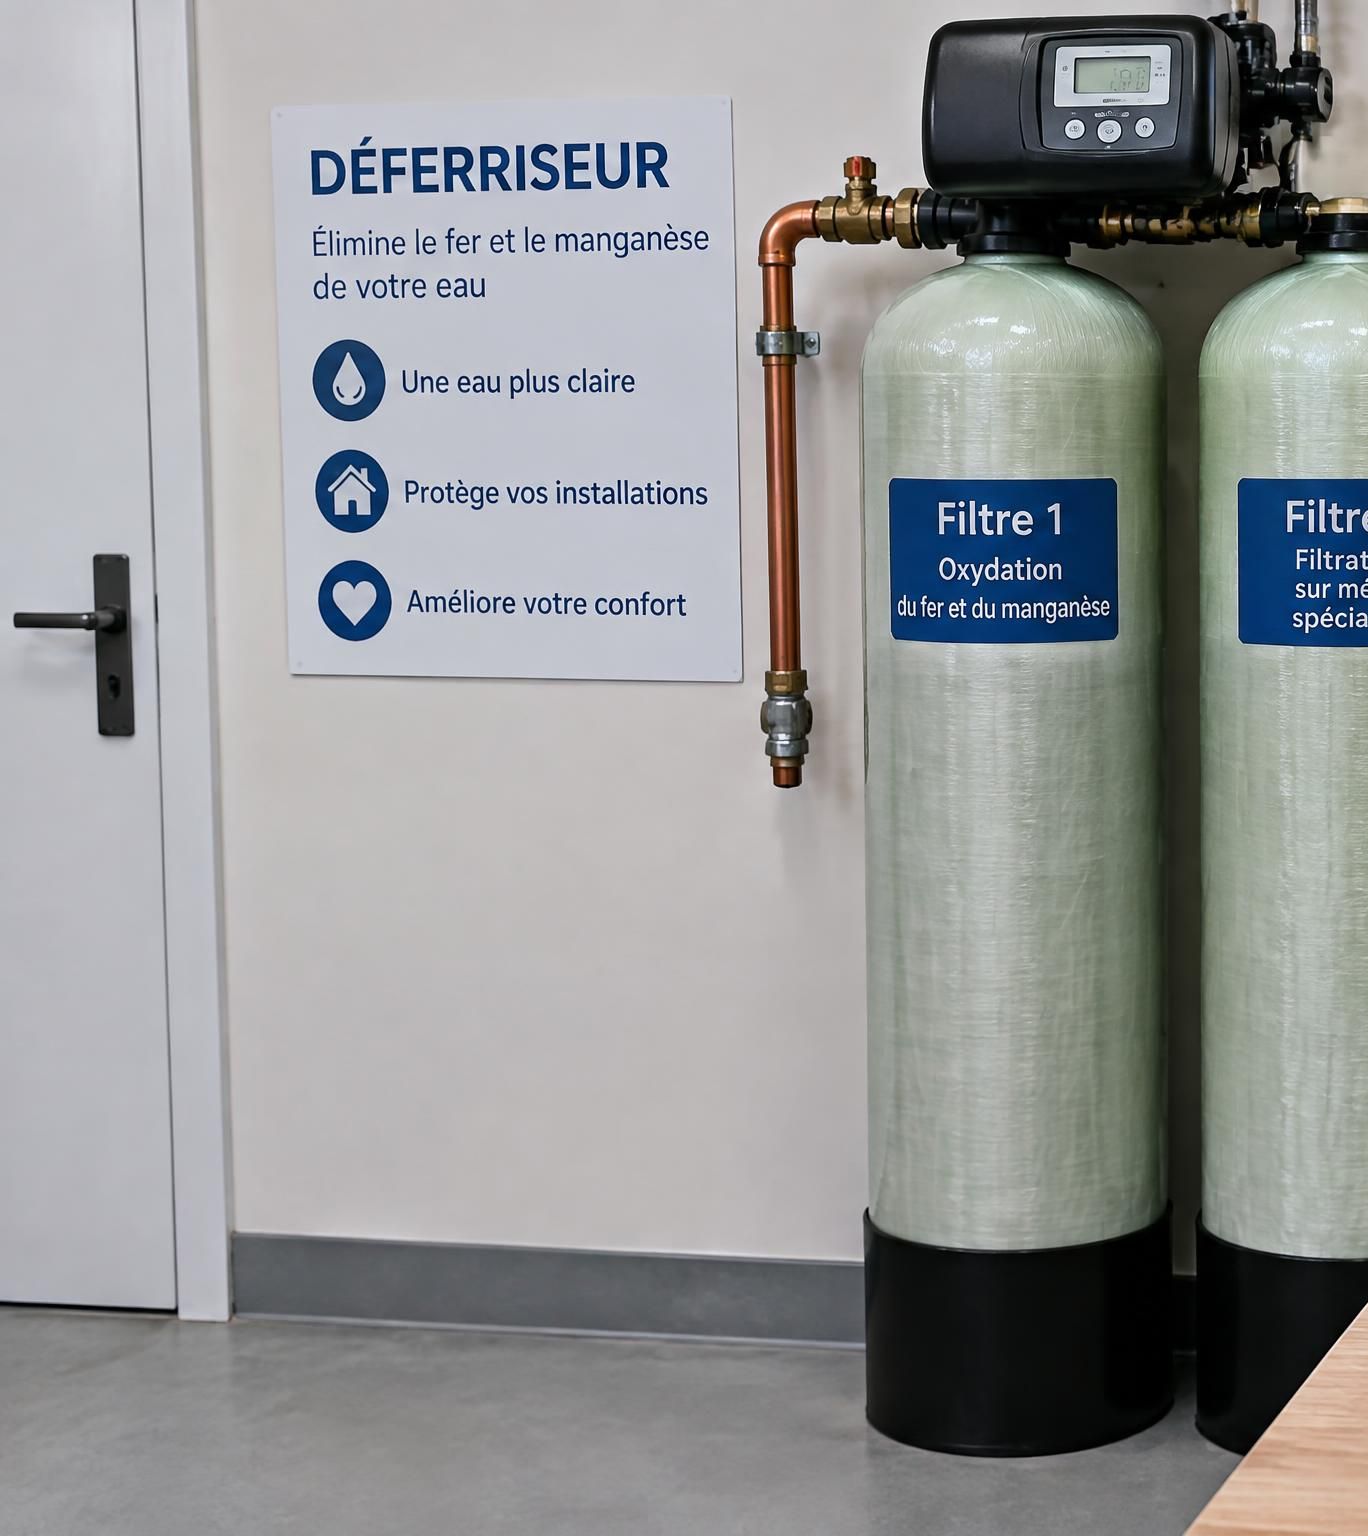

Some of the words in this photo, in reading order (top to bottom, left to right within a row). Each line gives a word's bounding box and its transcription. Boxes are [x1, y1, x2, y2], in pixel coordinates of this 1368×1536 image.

[310, 136, 669, 195] DÉFERRISEUR
[312, 224, 405, 256] Élimine
[415, 228, 436, 254] le
[444, 227, 481, 254] fer
[489, 229, 515, 253] et
[524, 226, 545, 252] le
[555, 223, 708, 258] manganèse
[313, 272, 346, 299] de
[355, 273, 426, 298] votre
[436, 277, 485, 298] eau
[402, 369, 448, 393] Une
[457, 375, 500, 393] eau
[509, 368, 559, 399] plus
[567, 367, 635, 393] claire
[404, 479, 499, 510] Protège
[506, 486, 548, 504] vos
[555, 479, 707, 505] installations
[938, 500, 1033, 535] Filtre
[1047, 502, 1060, 534] 1
[938, 556, 1061, 586] Oxydation
[406, 589, 515, 614] Améliore
[523, 592, 586, 615] votre
[594, 591, 686, 616] confort
[1295, 582, 1331, 598] sur
[897, 594, 916, 616] du
[920, 595, 944, 617] fer
[948, 598, 966, 618] et
[971, 596, 995, 618] du
[1001, 600, 1109, 623] manganèse
